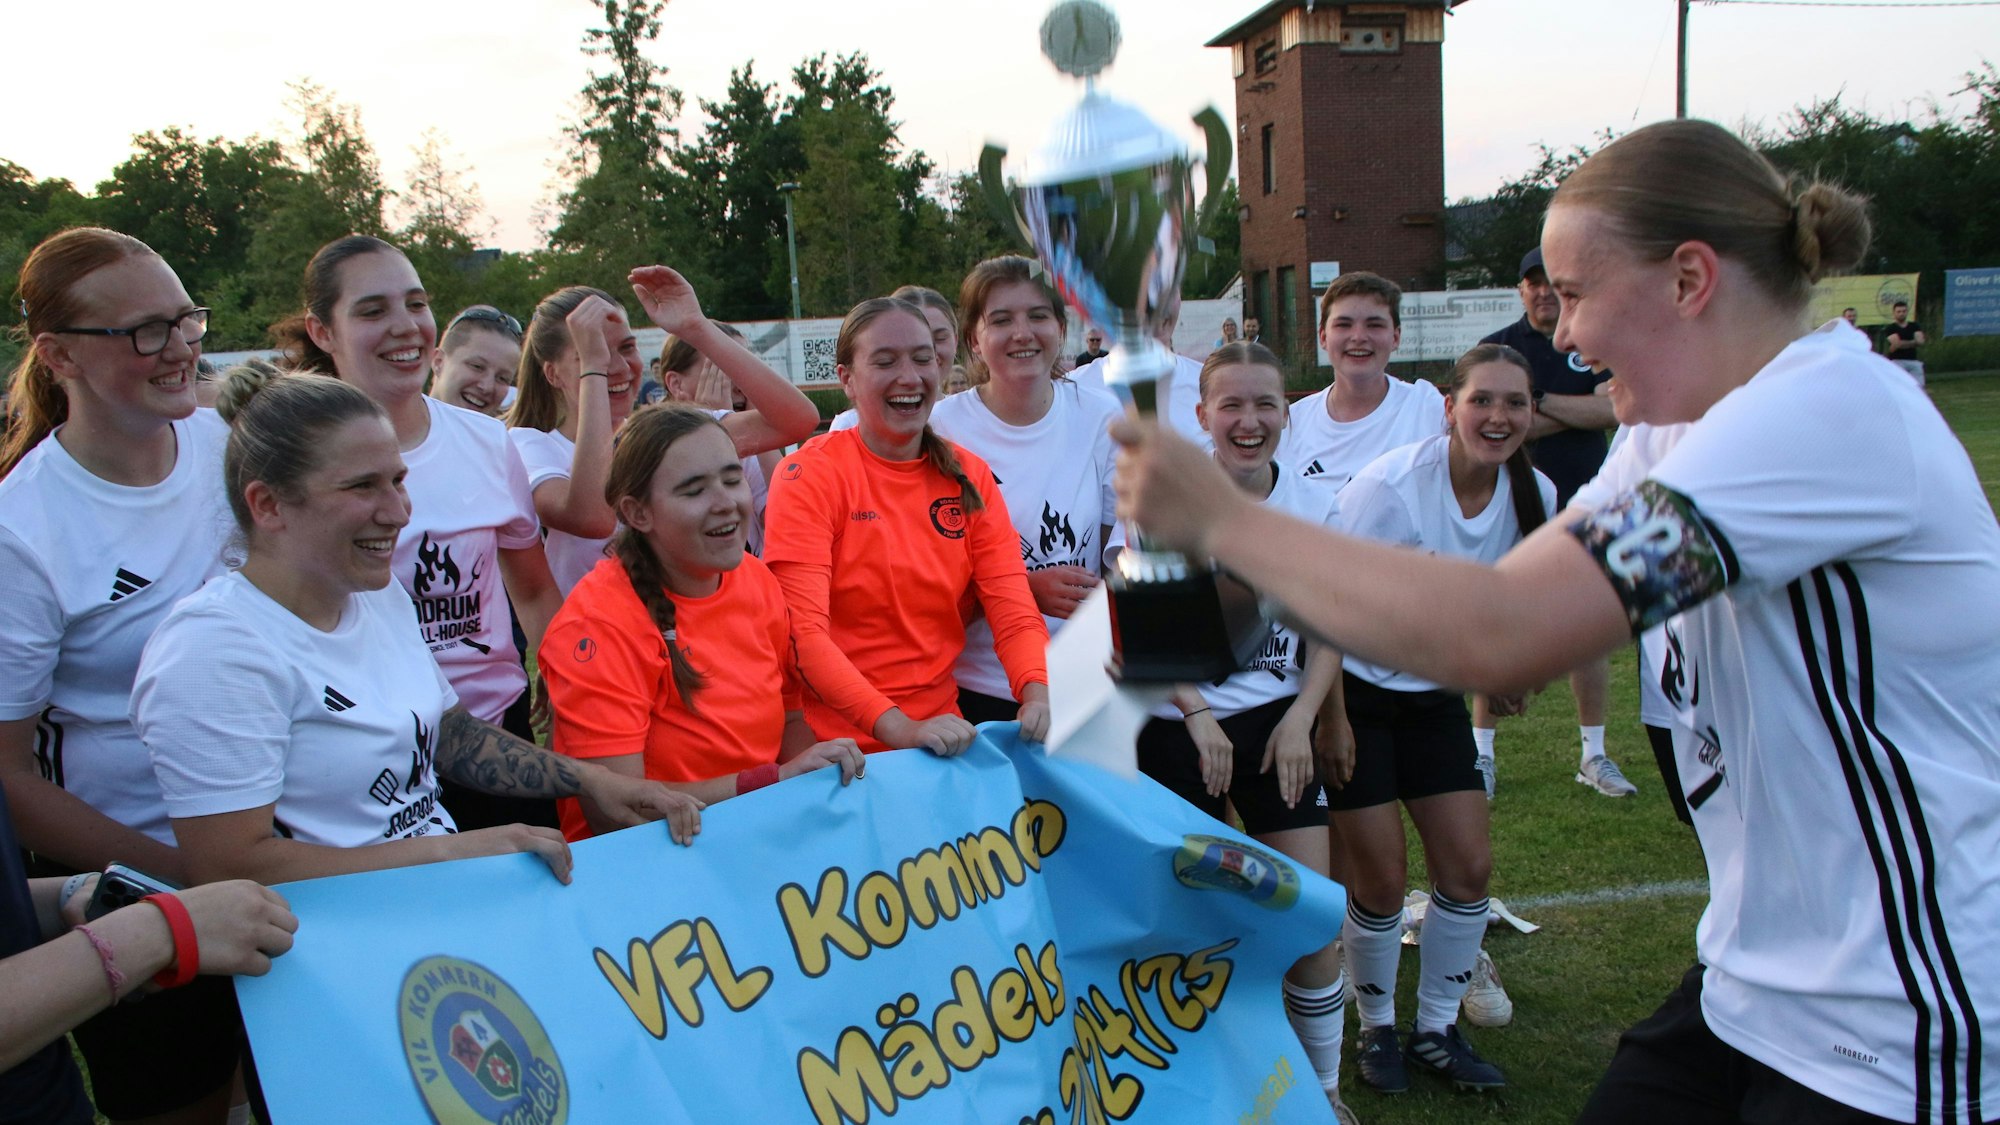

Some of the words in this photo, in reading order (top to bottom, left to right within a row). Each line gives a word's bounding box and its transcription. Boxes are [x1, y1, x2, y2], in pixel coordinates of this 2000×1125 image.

[1954, 274, 1990, 286] Oliver
[409, 965, 497, 1020] KOMMERN
[593, 916, 774, 1040] VFL
[797, 940, 1065, 1125] Mädels
[1833, 1044, 1879, 1064] AEROREADY
